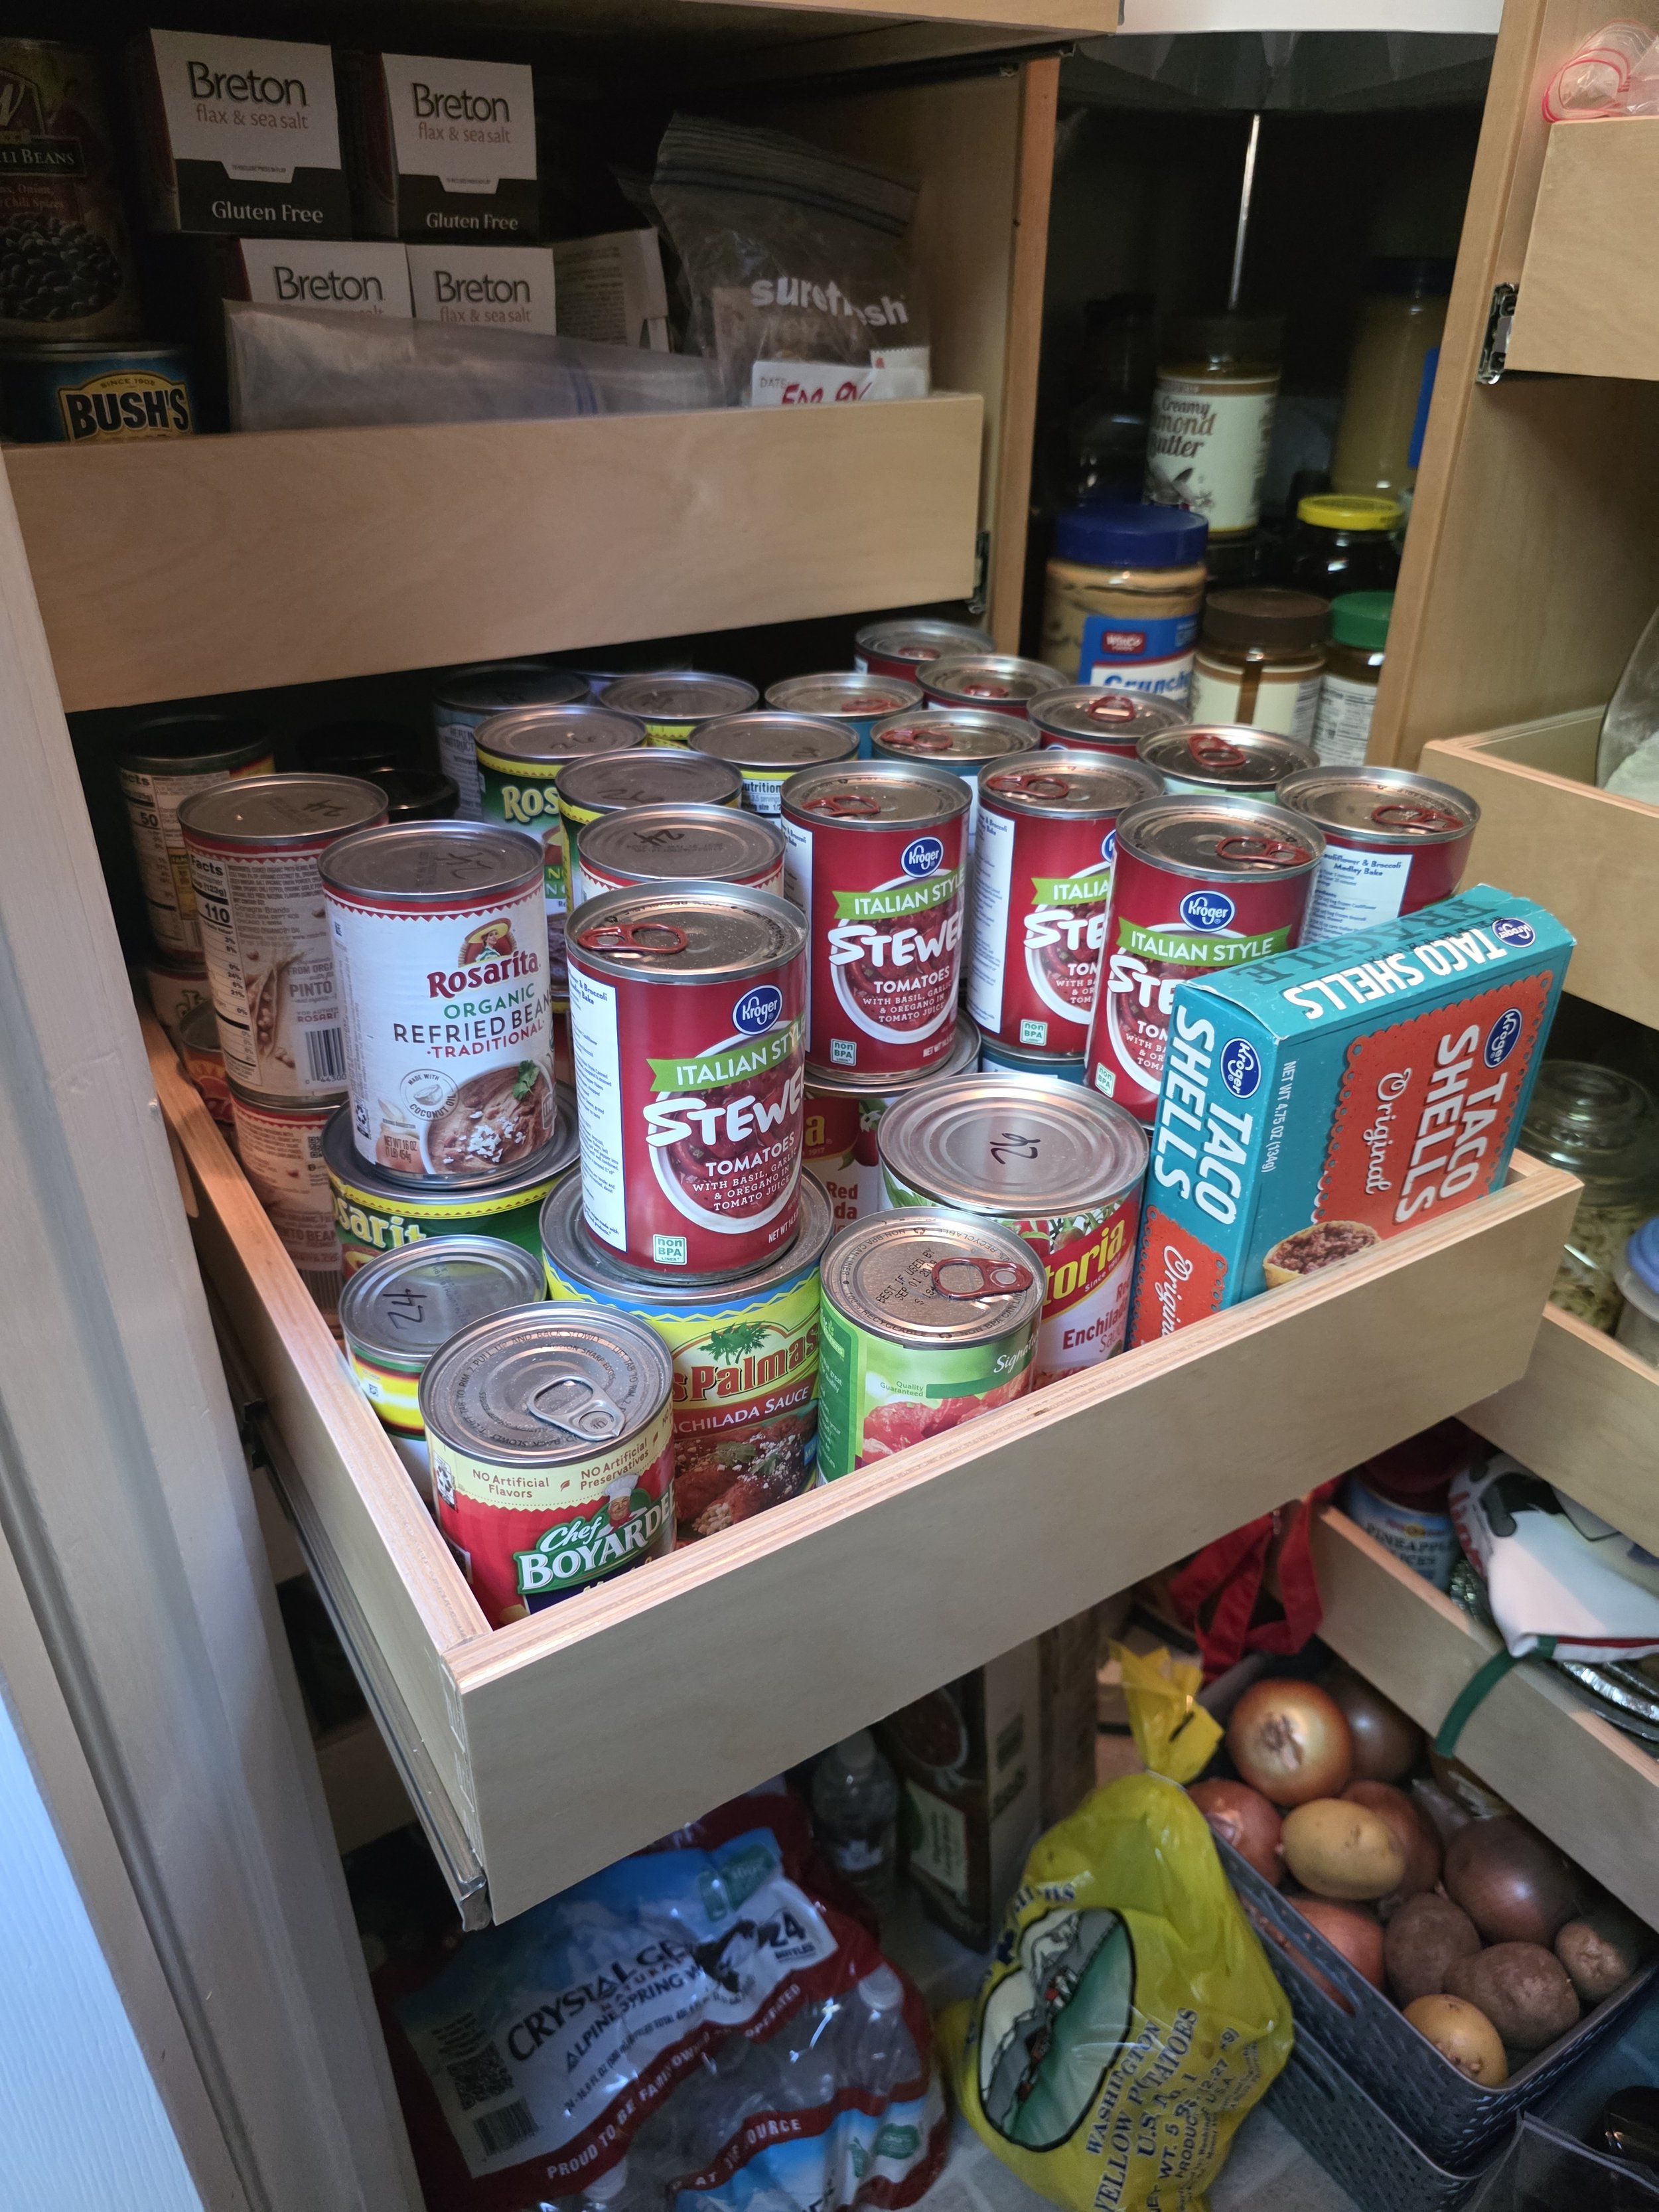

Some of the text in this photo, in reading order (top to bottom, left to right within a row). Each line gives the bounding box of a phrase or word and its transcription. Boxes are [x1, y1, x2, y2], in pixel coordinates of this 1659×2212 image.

[187, 61, 307, 106] Breton
[196, 104, 309, 129] flax & sea salt
[412, 83, 510, 122] Breton
[419, 121, 510, 143] flax & sea salt
[212, 200, 324, 224] Gluten Free
[426, 212, 518, 230] Gluten Free
[274, 266, 383, 301] Breton
[435, 271, 531, 303] Breton
[66, 388, 189, 439] BUSH'S
[1162, 396, 1210, 419] Creamy
[744, 782, 781, 793] utrition
[908, 845, 940, 870] Kroger
[205, 903, 230, 923] 110
[855, 889, 928, 915] ITALIAN
[1189, 897, 1228, 925] Kroger
[1131, 931, 1273, 962] ITALIAN STYLE
[1413, 928, 1508, 977] TACO
[427, 950, 539, 998] Rosarita
[873, 966, 950, 994] TOMATOES
[1056, 979, 1084, 988] WITH
[1108, 954, 1176, 1015] STE
[1283, 952, 1425, 1020] SHELLS
[290, 982, 332, 997] PINTO
[444, 983, 535, 1019] ORGANIC
[891, 997, 934, 1013] OREGANO
[936, 994, 944, 1003] IN
[742, 996, 778, 1025] Kroger
[879, 1001, 944, 1023] TOMATO JUICE
[394, 1017, 505, 1043] REFRIED
[430, 1019, 544, 1059] TRADITIONAL
[1024, 1030, 1043, 1039] BPA
[1125, 1033, 1152, 1049] WITH
[1491, 1012, 1516, 1063] Kroger
[834, 1041, 853, 1050] non
[834, 1049, 853, 1059] BPA
[407, 1074, 422, 1086] MADE
[676, 1047, 766, 1086] ITALIAN
[1228, 1042, 1254, 1094] Kroger
[1098, 1076, 1112, 1089] BPA
[409, 1094, 457, 1118] COCONUT OIL
[643, 1066, 803, 1147] STEWE
[1155, 1005, 1215, 1199] SHELLS
[1261, 1061, 1297, 1173] NET WT 4.75 OZ (134g)
[1363, 1068, 1412, 1195] Original
[1394, 1025, 1480, 1222] SHELLS
[1439, 1072, 1508, 1199] TACO
[402, 1140, 409, 1150] 16
[409, 1141, 417, 1151] OZ
[705, 1132, 795, 1177] TOMATOES
[1195, 1102, 1254, 1224] TACO
[693, 1181, 727, 1191] WITH
[733, 1171, 768, 1187] BASIL,
[713, 1175, 790, 1211] TOMATO JUICE
[727, 1173, 778, 1199] OREGANO
[782, 1165, 790, 1176] IN
[658, 1237, 683, 1248] non
[768, 1230, 780, 1243] NET
[658, 1247, 682, 1257] BPA
[1043, 1220, 1125, 1305] toria
[875, 1286, 893, 1304] BEST
[906, 1256, 926, 1276] USED
[922, 1248, 935, 1262] BY
[1084, 1271, 1106, 1292] Since
[897, 1286, 910, 1301] SEP
[1155, 1246, 1193, 1337] Origin
[512, 1333, 533, 1346] AND
[537, 1329, 562, 1338] BACK
[880, 1382, 924, 1398] Guaranteed
[896, 1380, 924, 1392] Quality
[674, 1387, 809, 1434] NCHILADA SAUCE
[581, 1466, 600, 1479] NO
[604, 1439, 648, 1473] Artificial
[581, 1449, 649, 1491] Preservatives
[472, 1469, 549, 1488] NO Artificial
[489, 1484, 532, 1499] Flavors
[540, 1516, 603, 1553] Chef
[508, 1960, 637, 2061] CRYSTAL
[565, 2008, 617, 2073] ALPINE
[1086, 2020, 1161, 2155] WASHINGTON
[547, 2143, 599, 2179] PROUD
[599, 2124, 618, 2148] TO
